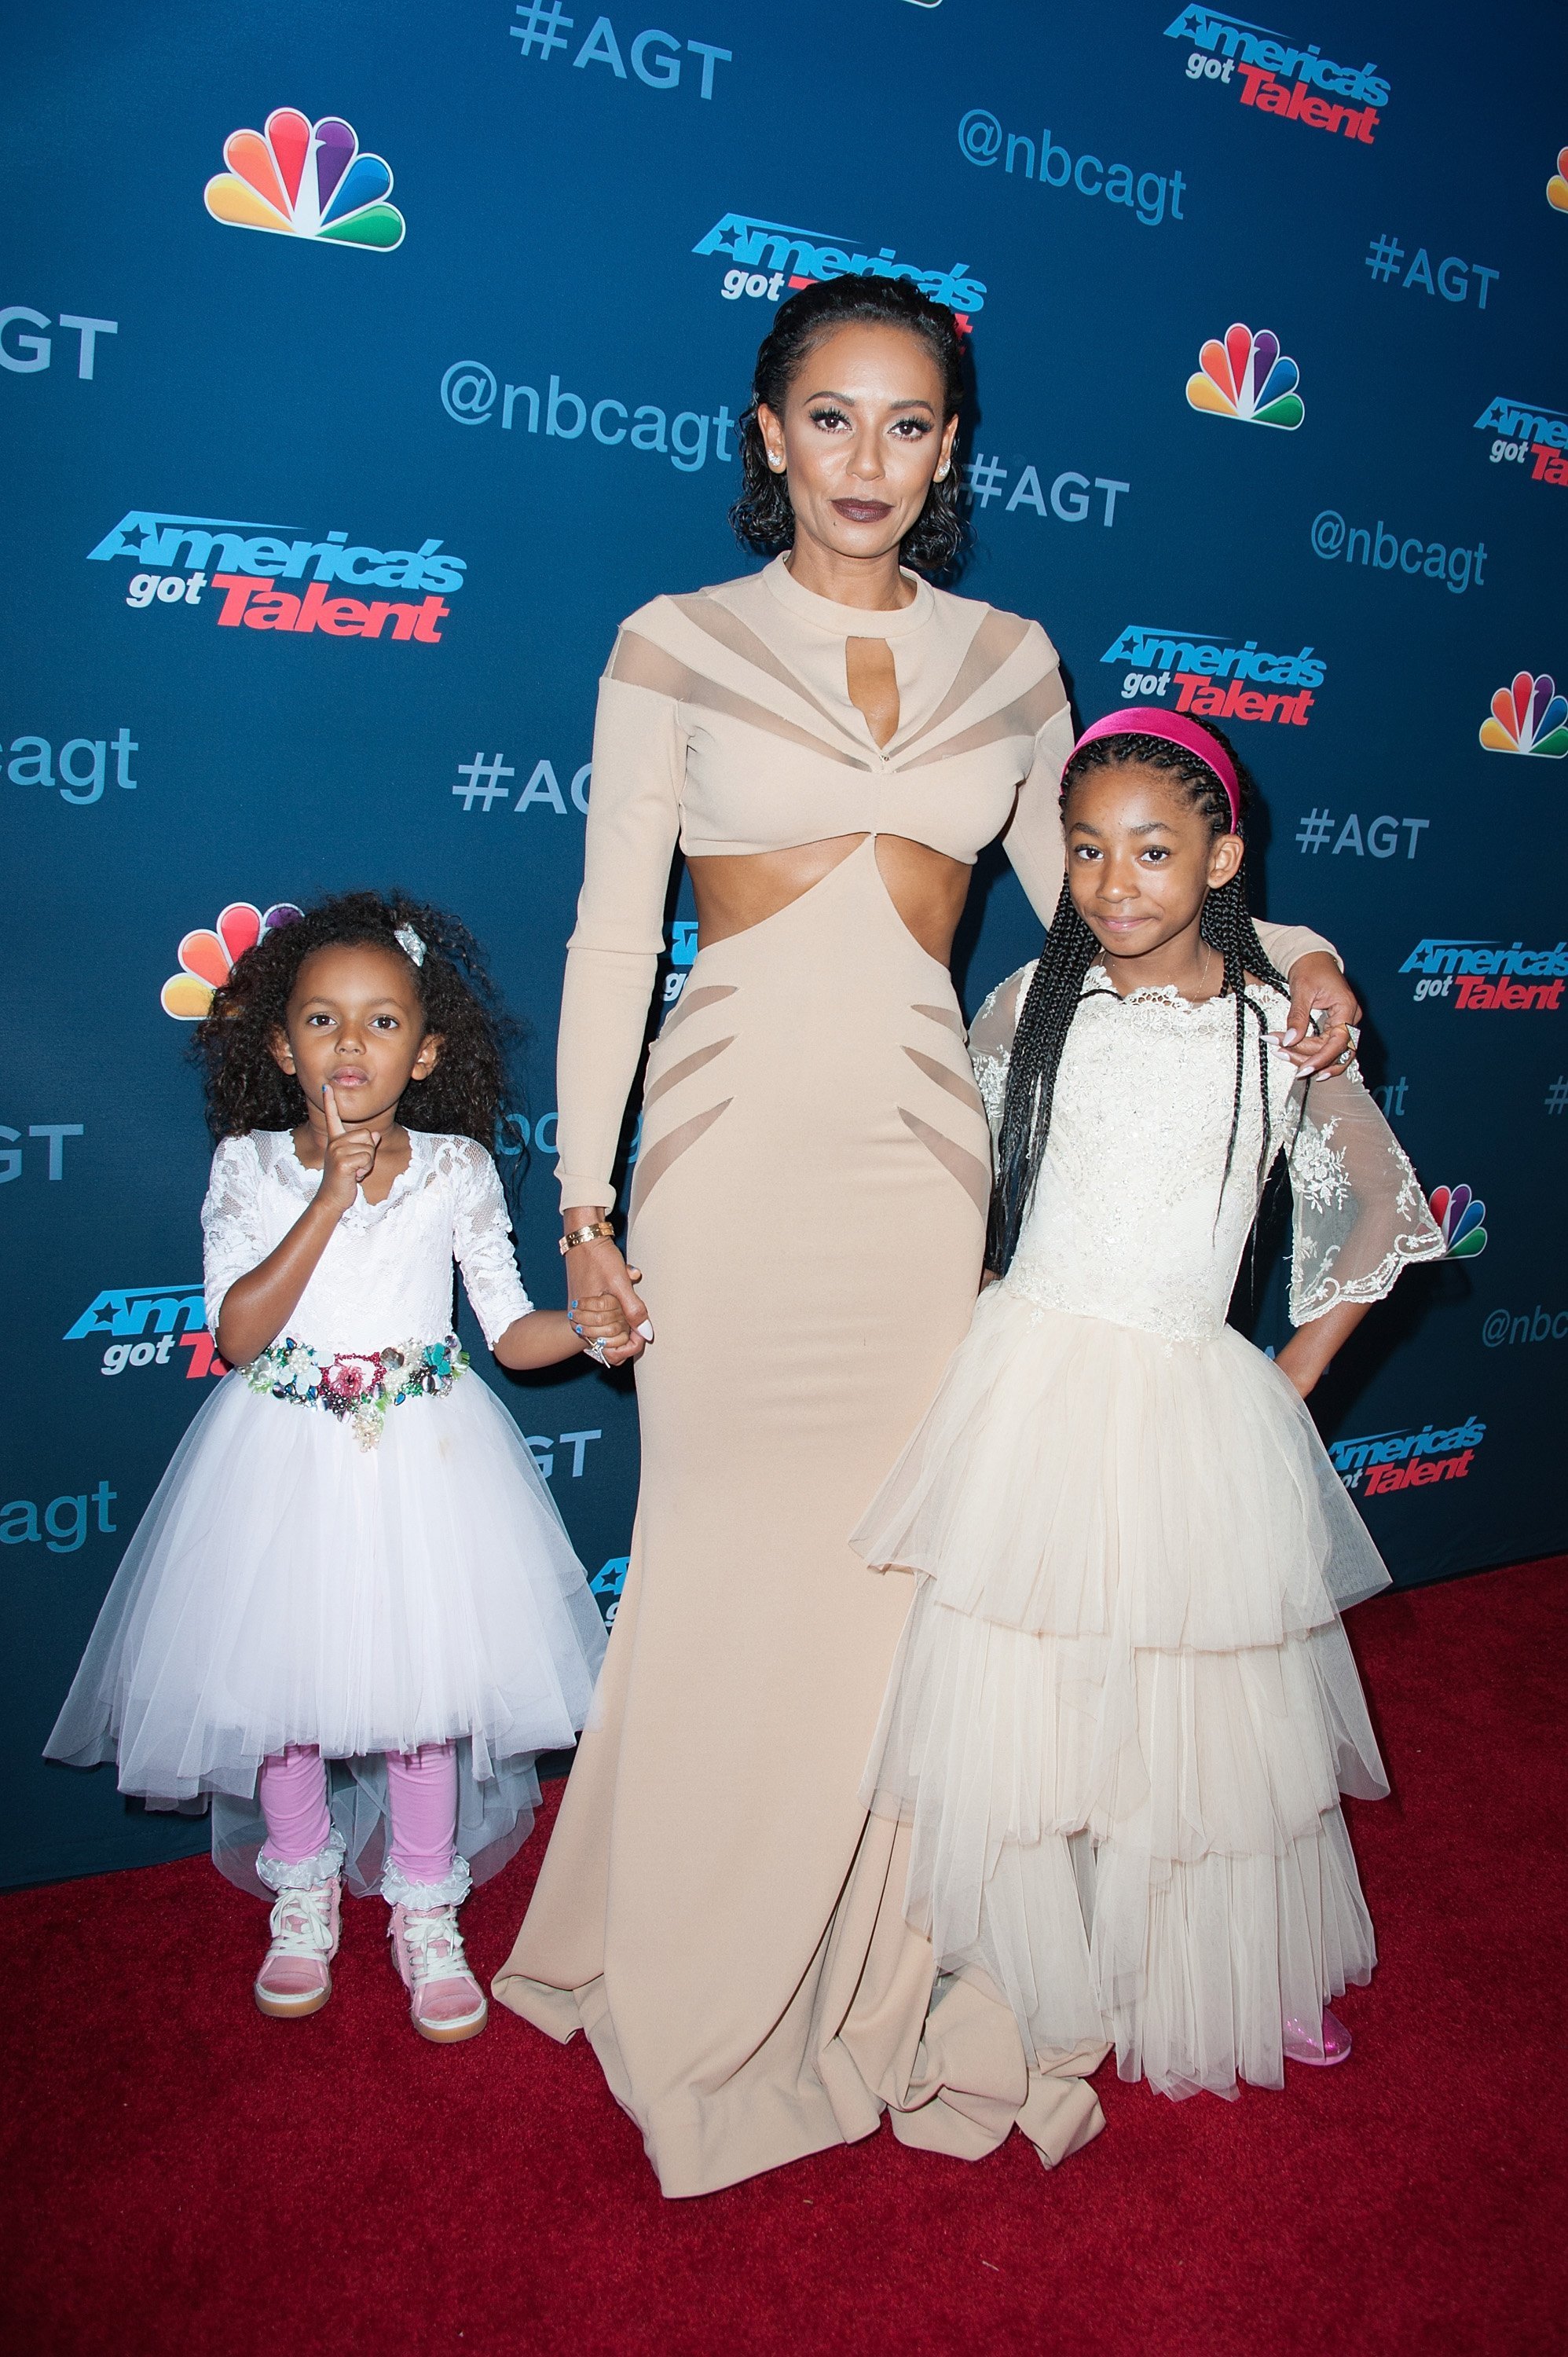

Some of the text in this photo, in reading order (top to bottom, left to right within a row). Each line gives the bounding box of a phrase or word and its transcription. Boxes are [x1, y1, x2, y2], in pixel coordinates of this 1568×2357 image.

[510, 0, 733, 101] #AGT
[1163, 2, 1391, 108] America's
[1185, 53, 1380, 145] got Talent
[958, 108, 1186, 225] @nbcagt
[721, 269, 785, 302] got
[1365, 233, 1500, 310] #AGT
[441, 360, 735, 472] @nbcagt
[1473, 396, 1568, 451] Ame
[1489, 439, 1529, 464] got
[959, 453, 1130, 527] #AGT
[86, 511, 467, 593] America's
[1311, 510, 1488, 594] @nbcagt
[126, 572, 450, 643] got Talent
[1100, 625, 1328, 687] America's
[1121, 672, 1315, 726] got Talent
[0, 728, 139, 805] agt
[1295, 808, 1431, 860] #AGT
[1413, 975, 1566, 1010] got Talent
[101, 1334, 176, 1376] got
[1364, 1449, 1475, 1497] Talent
